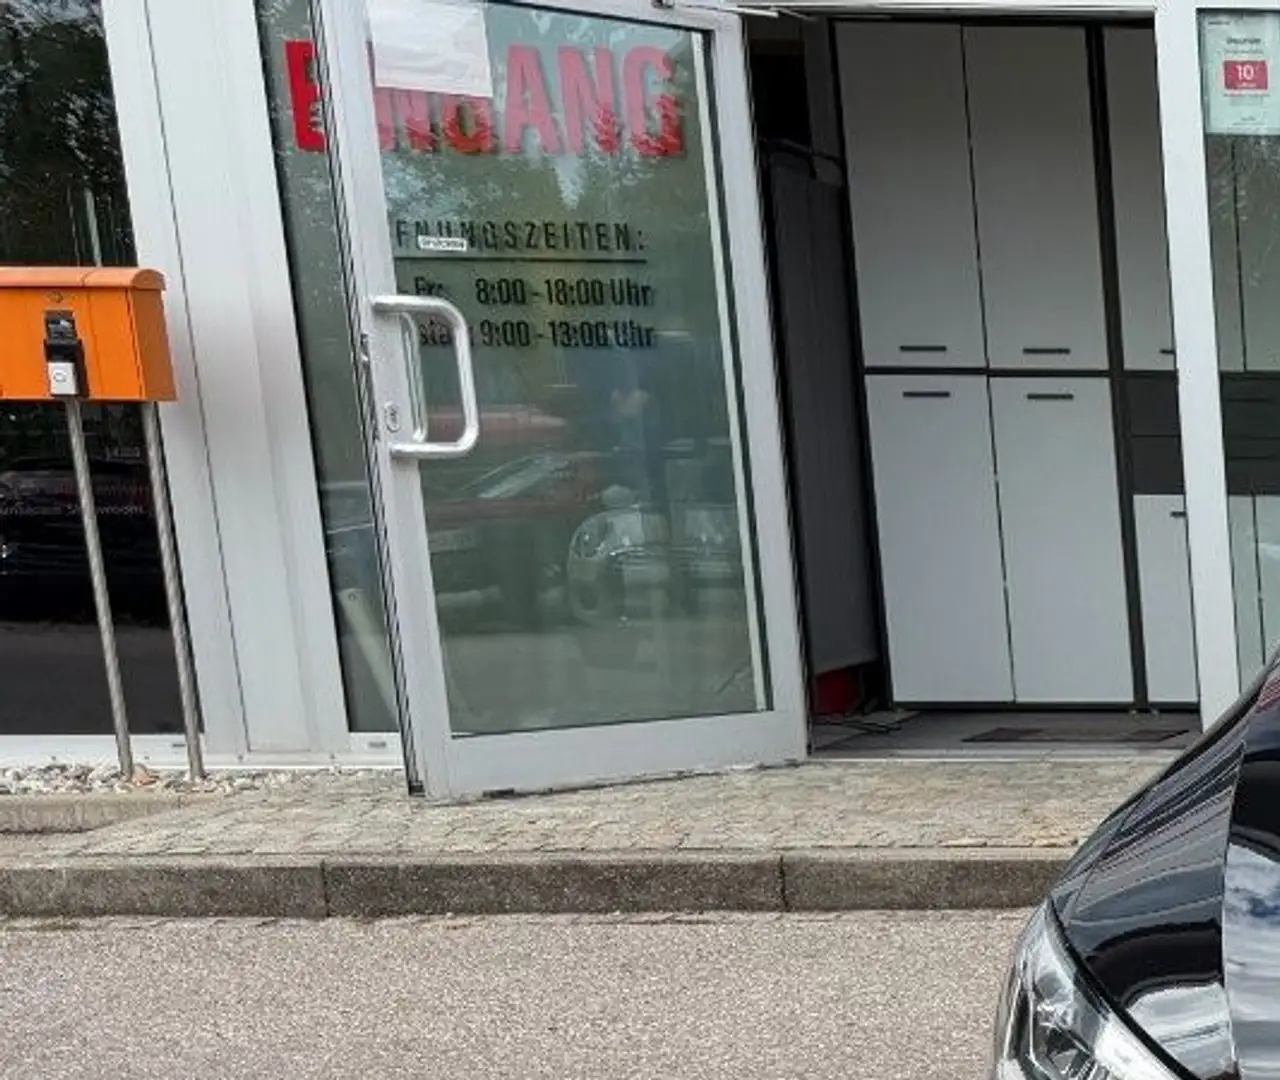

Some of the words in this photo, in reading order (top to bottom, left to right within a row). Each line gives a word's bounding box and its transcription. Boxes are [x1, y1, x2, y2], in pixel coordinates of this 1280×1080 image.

[284, 40, 685, 157] ENGANG
[475, 278, 526, 304] 8:00
[545, 279, 605, 305] 18:00
[609, 279, 653, 306] Uhr
[480, 319, 530, 347] 9:00
[548, 320, 608, 348] 13:00
[613, 320, 654, 347] Uhr
